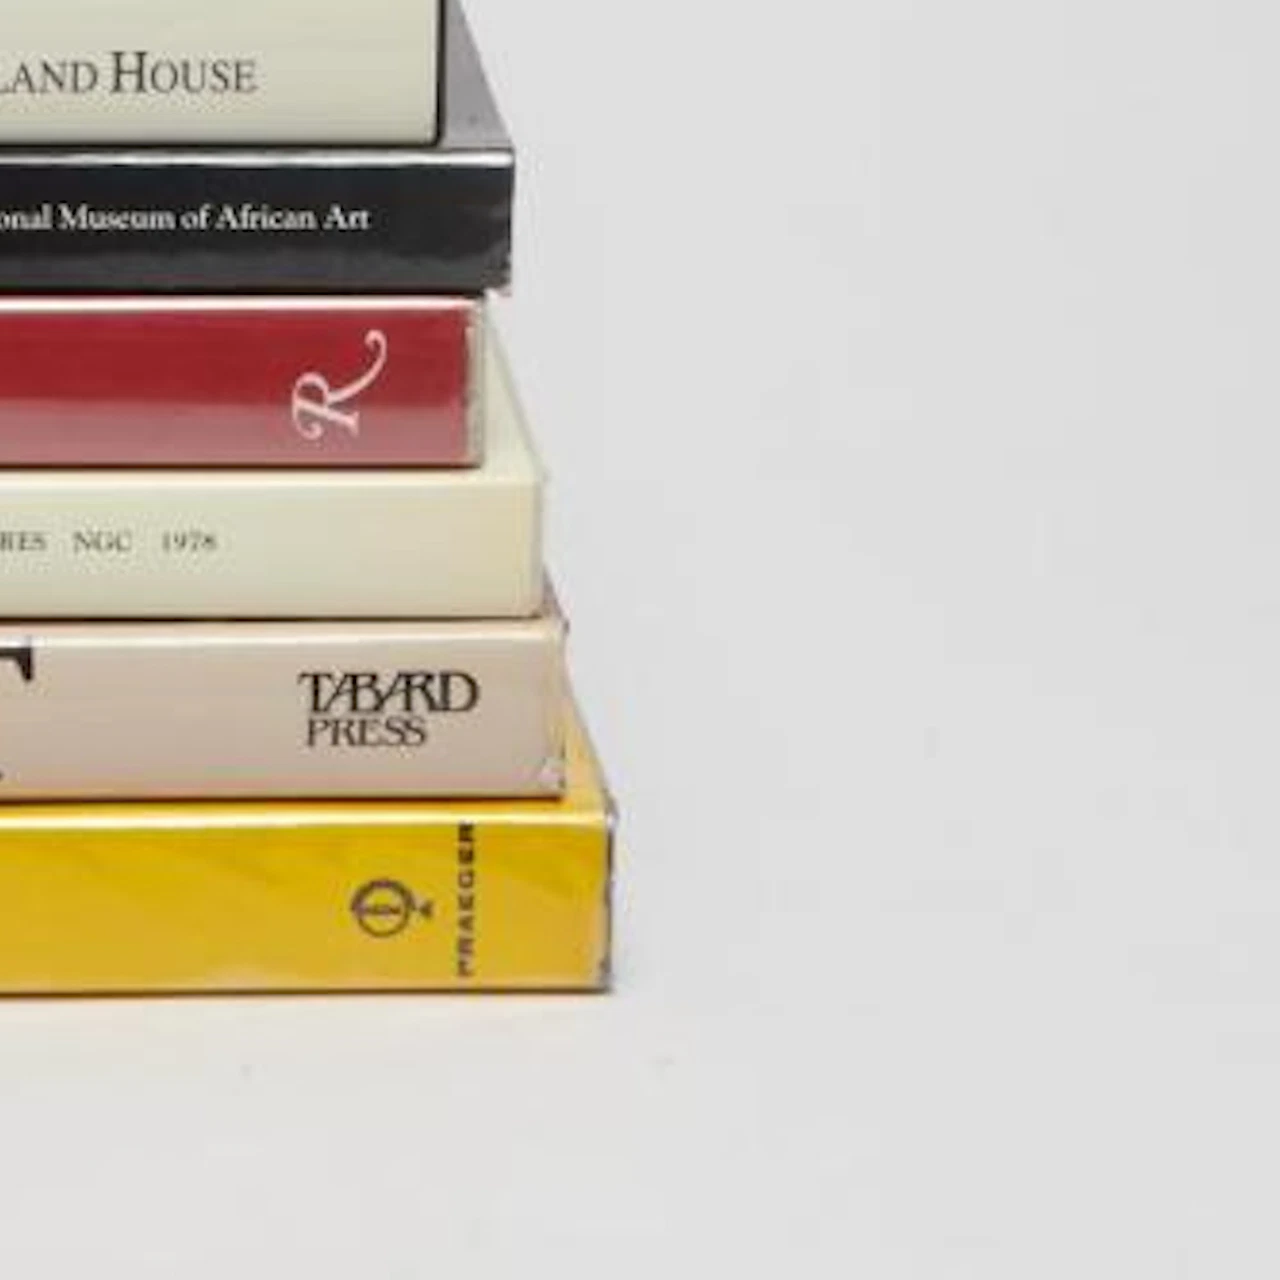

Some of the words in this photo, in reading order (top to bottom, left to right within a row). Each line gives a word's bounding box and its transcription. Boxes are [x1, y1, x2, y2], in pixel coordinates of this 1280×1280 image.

[110, 50, 258, 94] HOUSE
[58, 203, 176, 234] Museum
[180, 202, 211, 234] of
[214, 202, 317, 234] African
[323, 203, 372, 234] Art
[291, 328, 388, 440] R
[71, 529, 133, 554] NGC
[160, 529, 220, 554] 1978
[297, 670, 481, 713] TABARD
[305, 714, 428, 747] PRESS
[457, 822, 476, 978] PRAEGER
